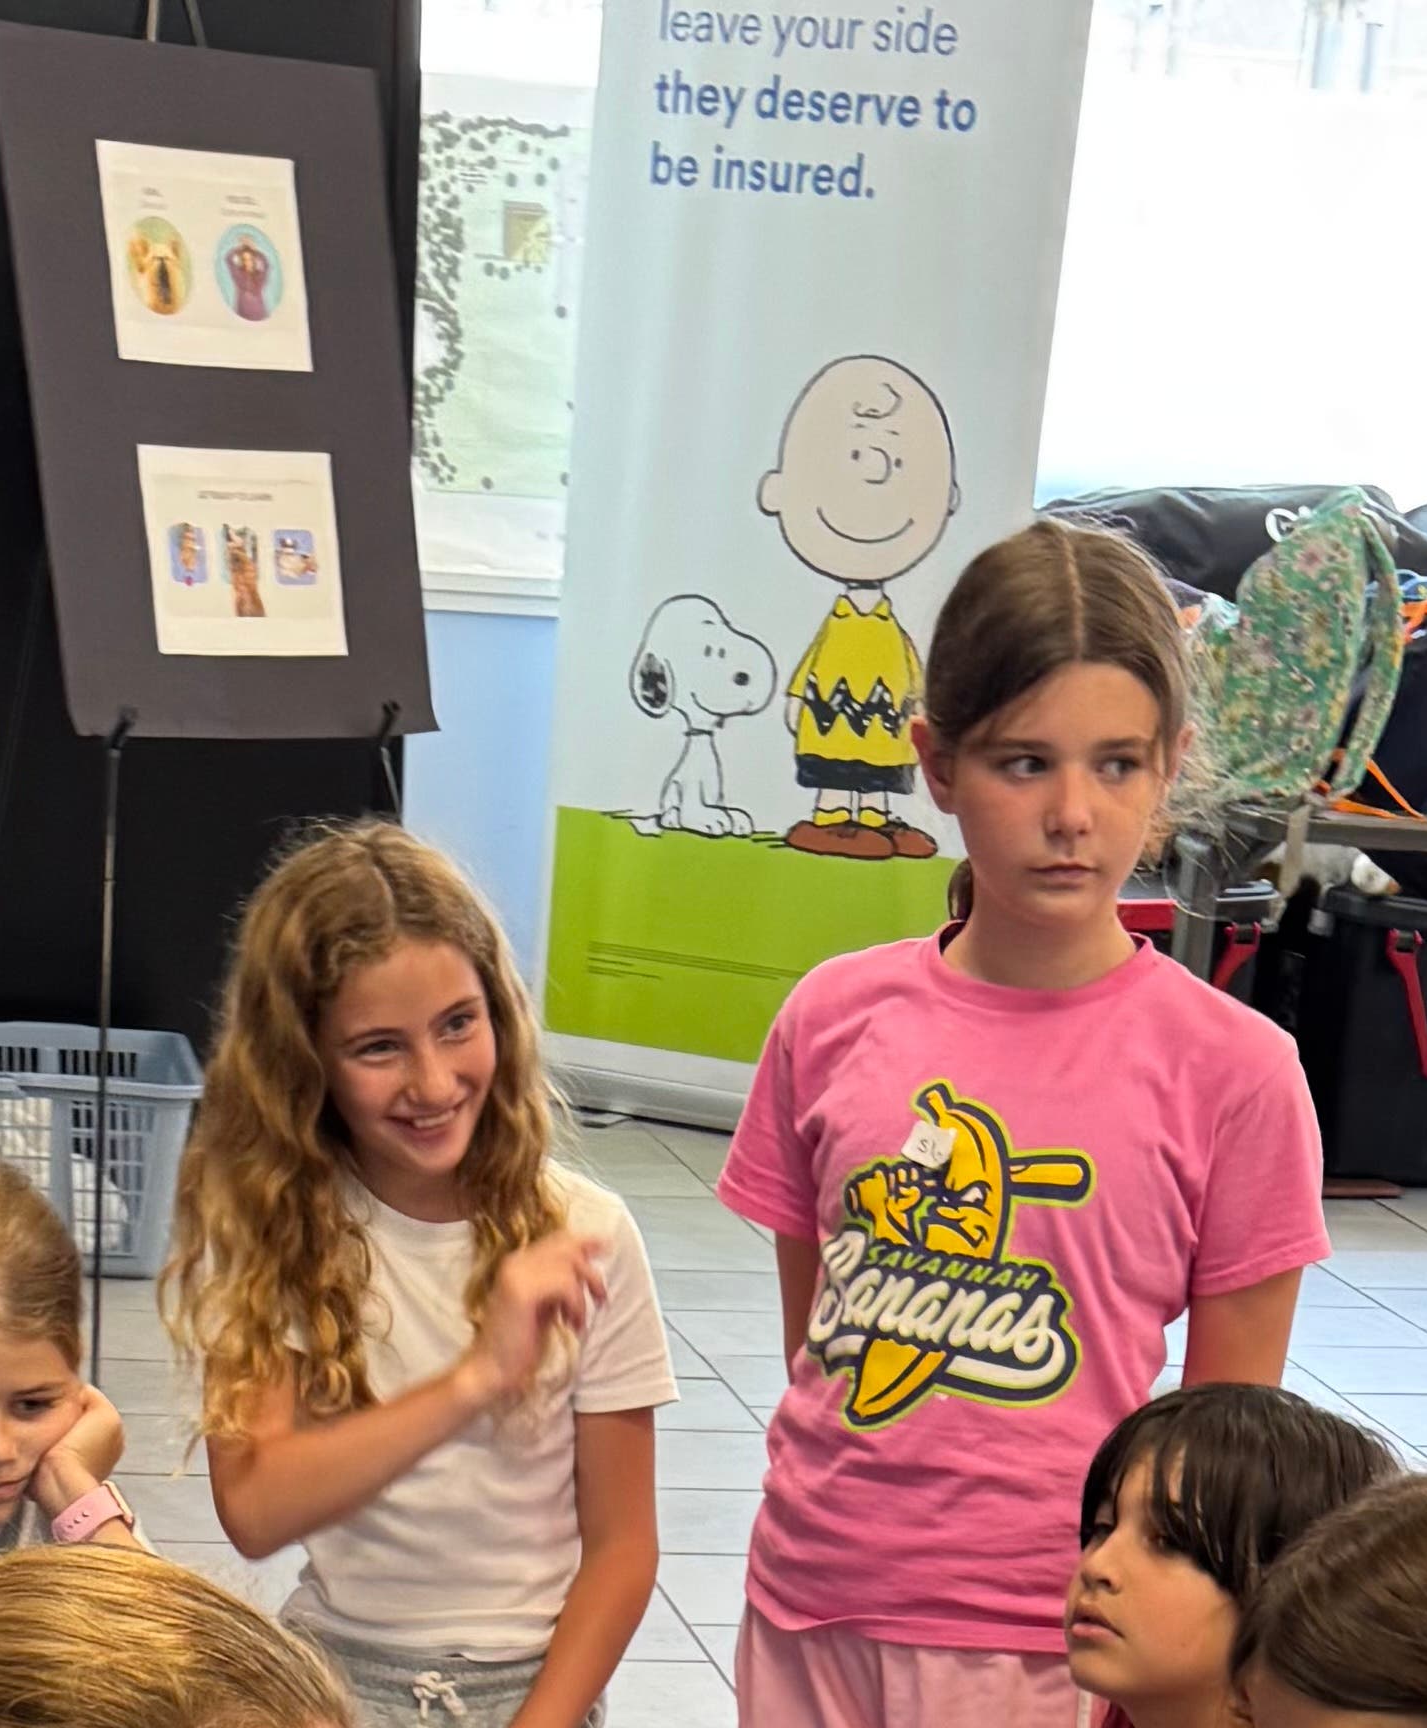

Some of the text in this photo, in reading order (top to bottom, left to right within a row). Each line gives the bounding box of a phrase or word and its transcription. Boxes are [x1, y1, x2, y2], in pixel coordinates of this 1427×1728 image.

[660, 0, 959, 57] leave your side
[655, 69, 978, 131] they deserve to
[651, 140, 875, 199] be insured.
[865, 1244, 1040, 1291] SAVANNAH
